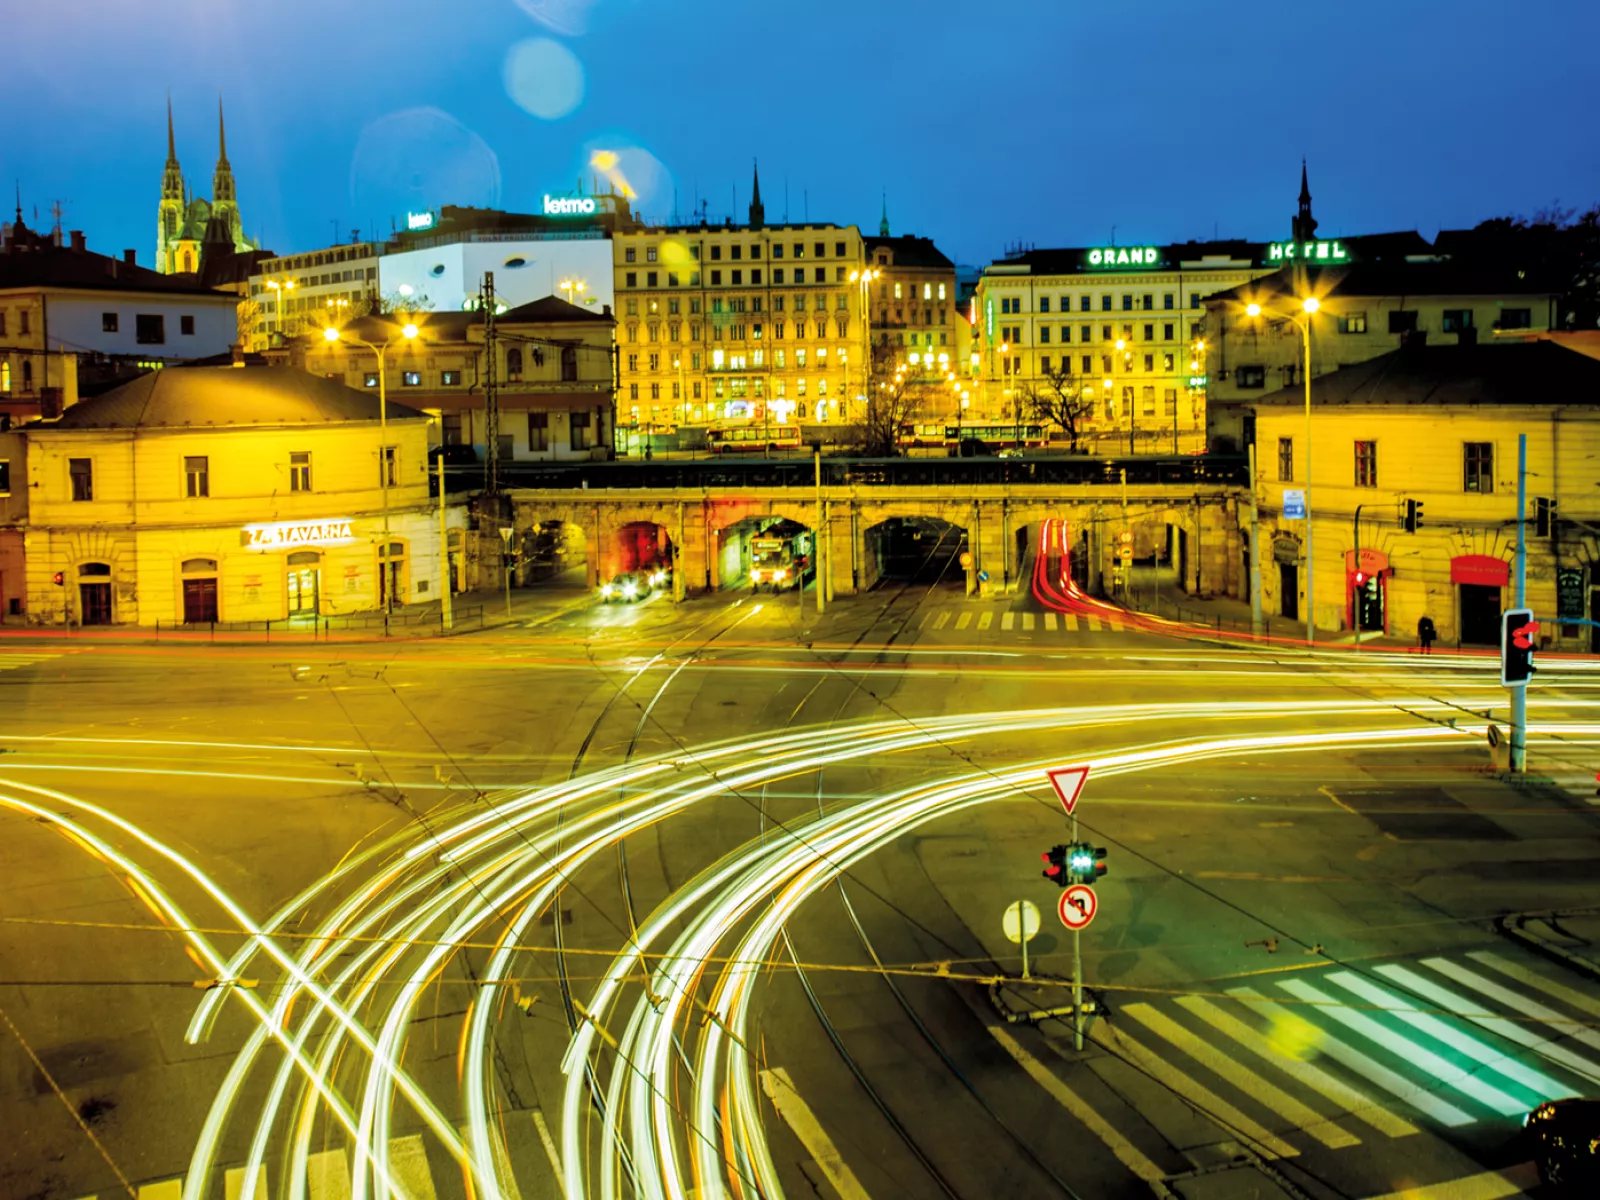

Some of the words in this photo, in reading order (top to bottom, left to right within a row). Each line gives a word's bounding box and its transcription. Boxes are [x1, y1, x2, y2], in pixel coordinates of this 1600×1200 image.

[544, 194, 595, 214] letmo
[1089, 248, 1157, 264] GRAND
[1270, 242, 1346, 260] HOTEL
